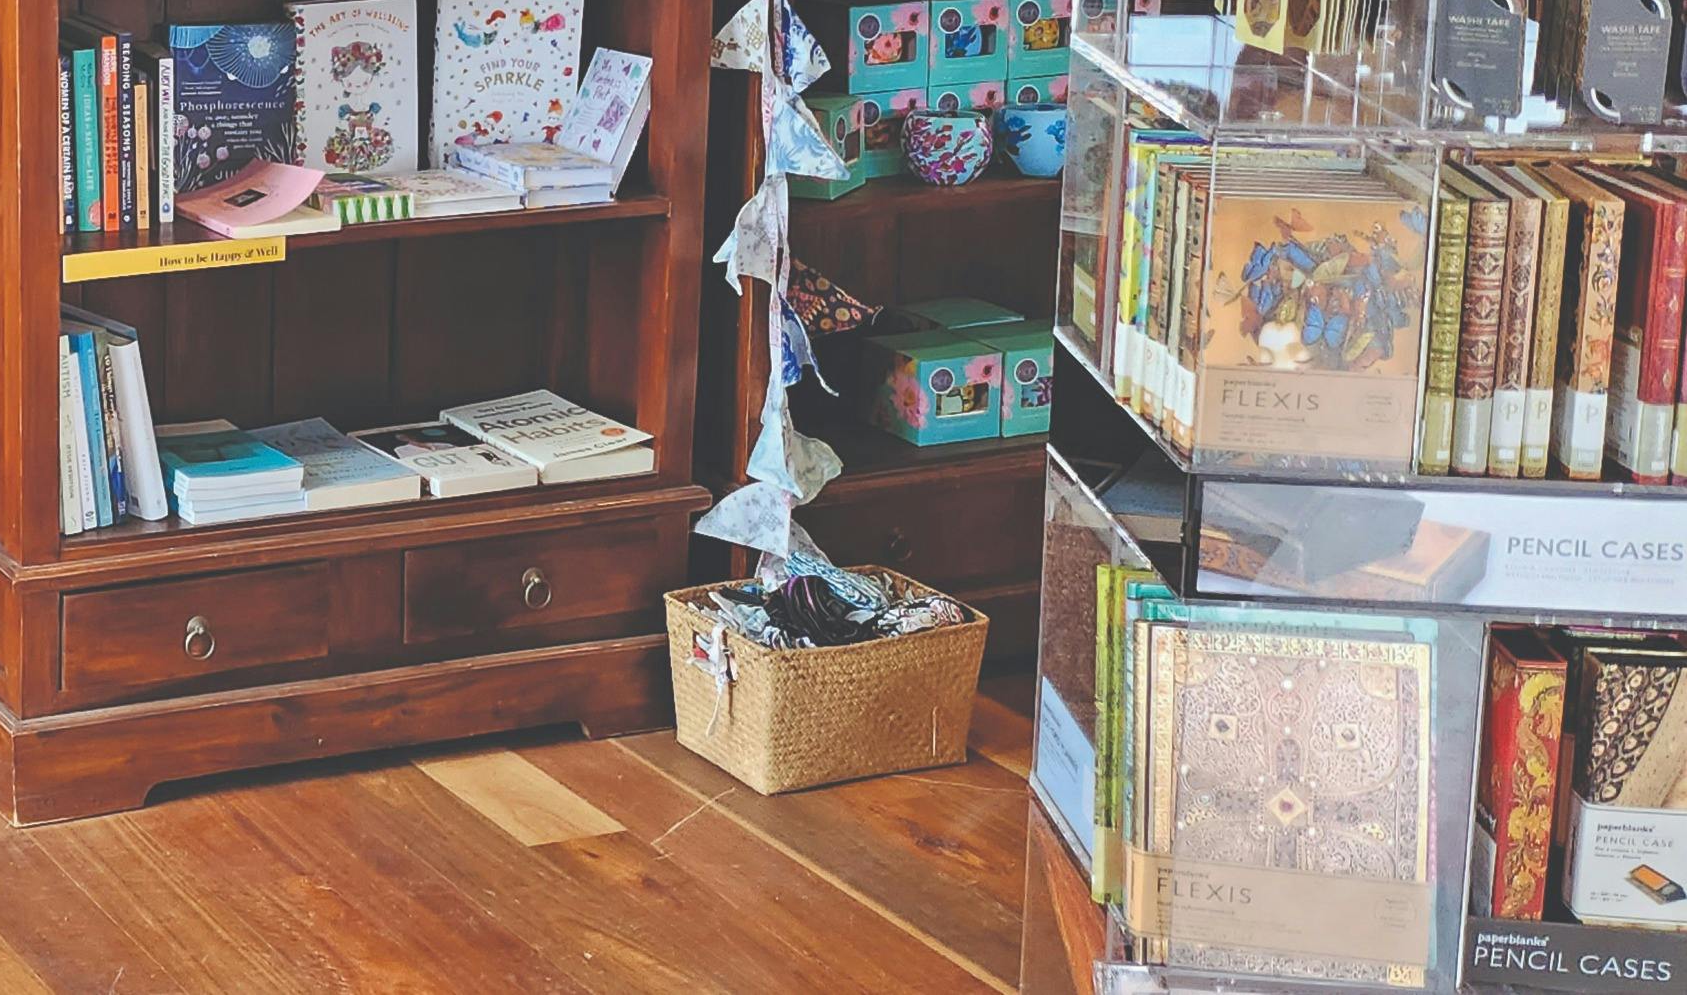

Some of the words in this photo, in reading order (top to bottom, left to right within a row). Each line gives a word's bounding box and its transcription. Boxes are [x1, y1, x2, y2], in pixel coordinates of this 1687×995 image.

[1487, 18, 1510, 27] TAPE
[480, 59, 507, 74] FIND
[511, 58, 540, 71] YOUR
[474, 72, 545, 92] SPARKLE
[180, 101, 285, 111] Phosphorescence
[159, 257, 182, 267] How
[211, 252, 242, 262] Happy
[244, 250, 253, 258] &
[256, 247, 278, 256] Well
[1222, 388, 1320, 410] FLEXIS
[480, 405, 590, 435] Atomic
[501, 415, 607, 445] Habits
[413, 450, 467, 470] GUT
[1507, 537, 1592, 559] PENCIL
[1601, 540, 1684, 560] CASES
[1157, 879, 1252, 904] FLEXIS
[1478, 933, 1549, 946] paperblanks
[1474, 948, 1568, 973] PENCIL
[1580, 955, 1671, 980] CASES
